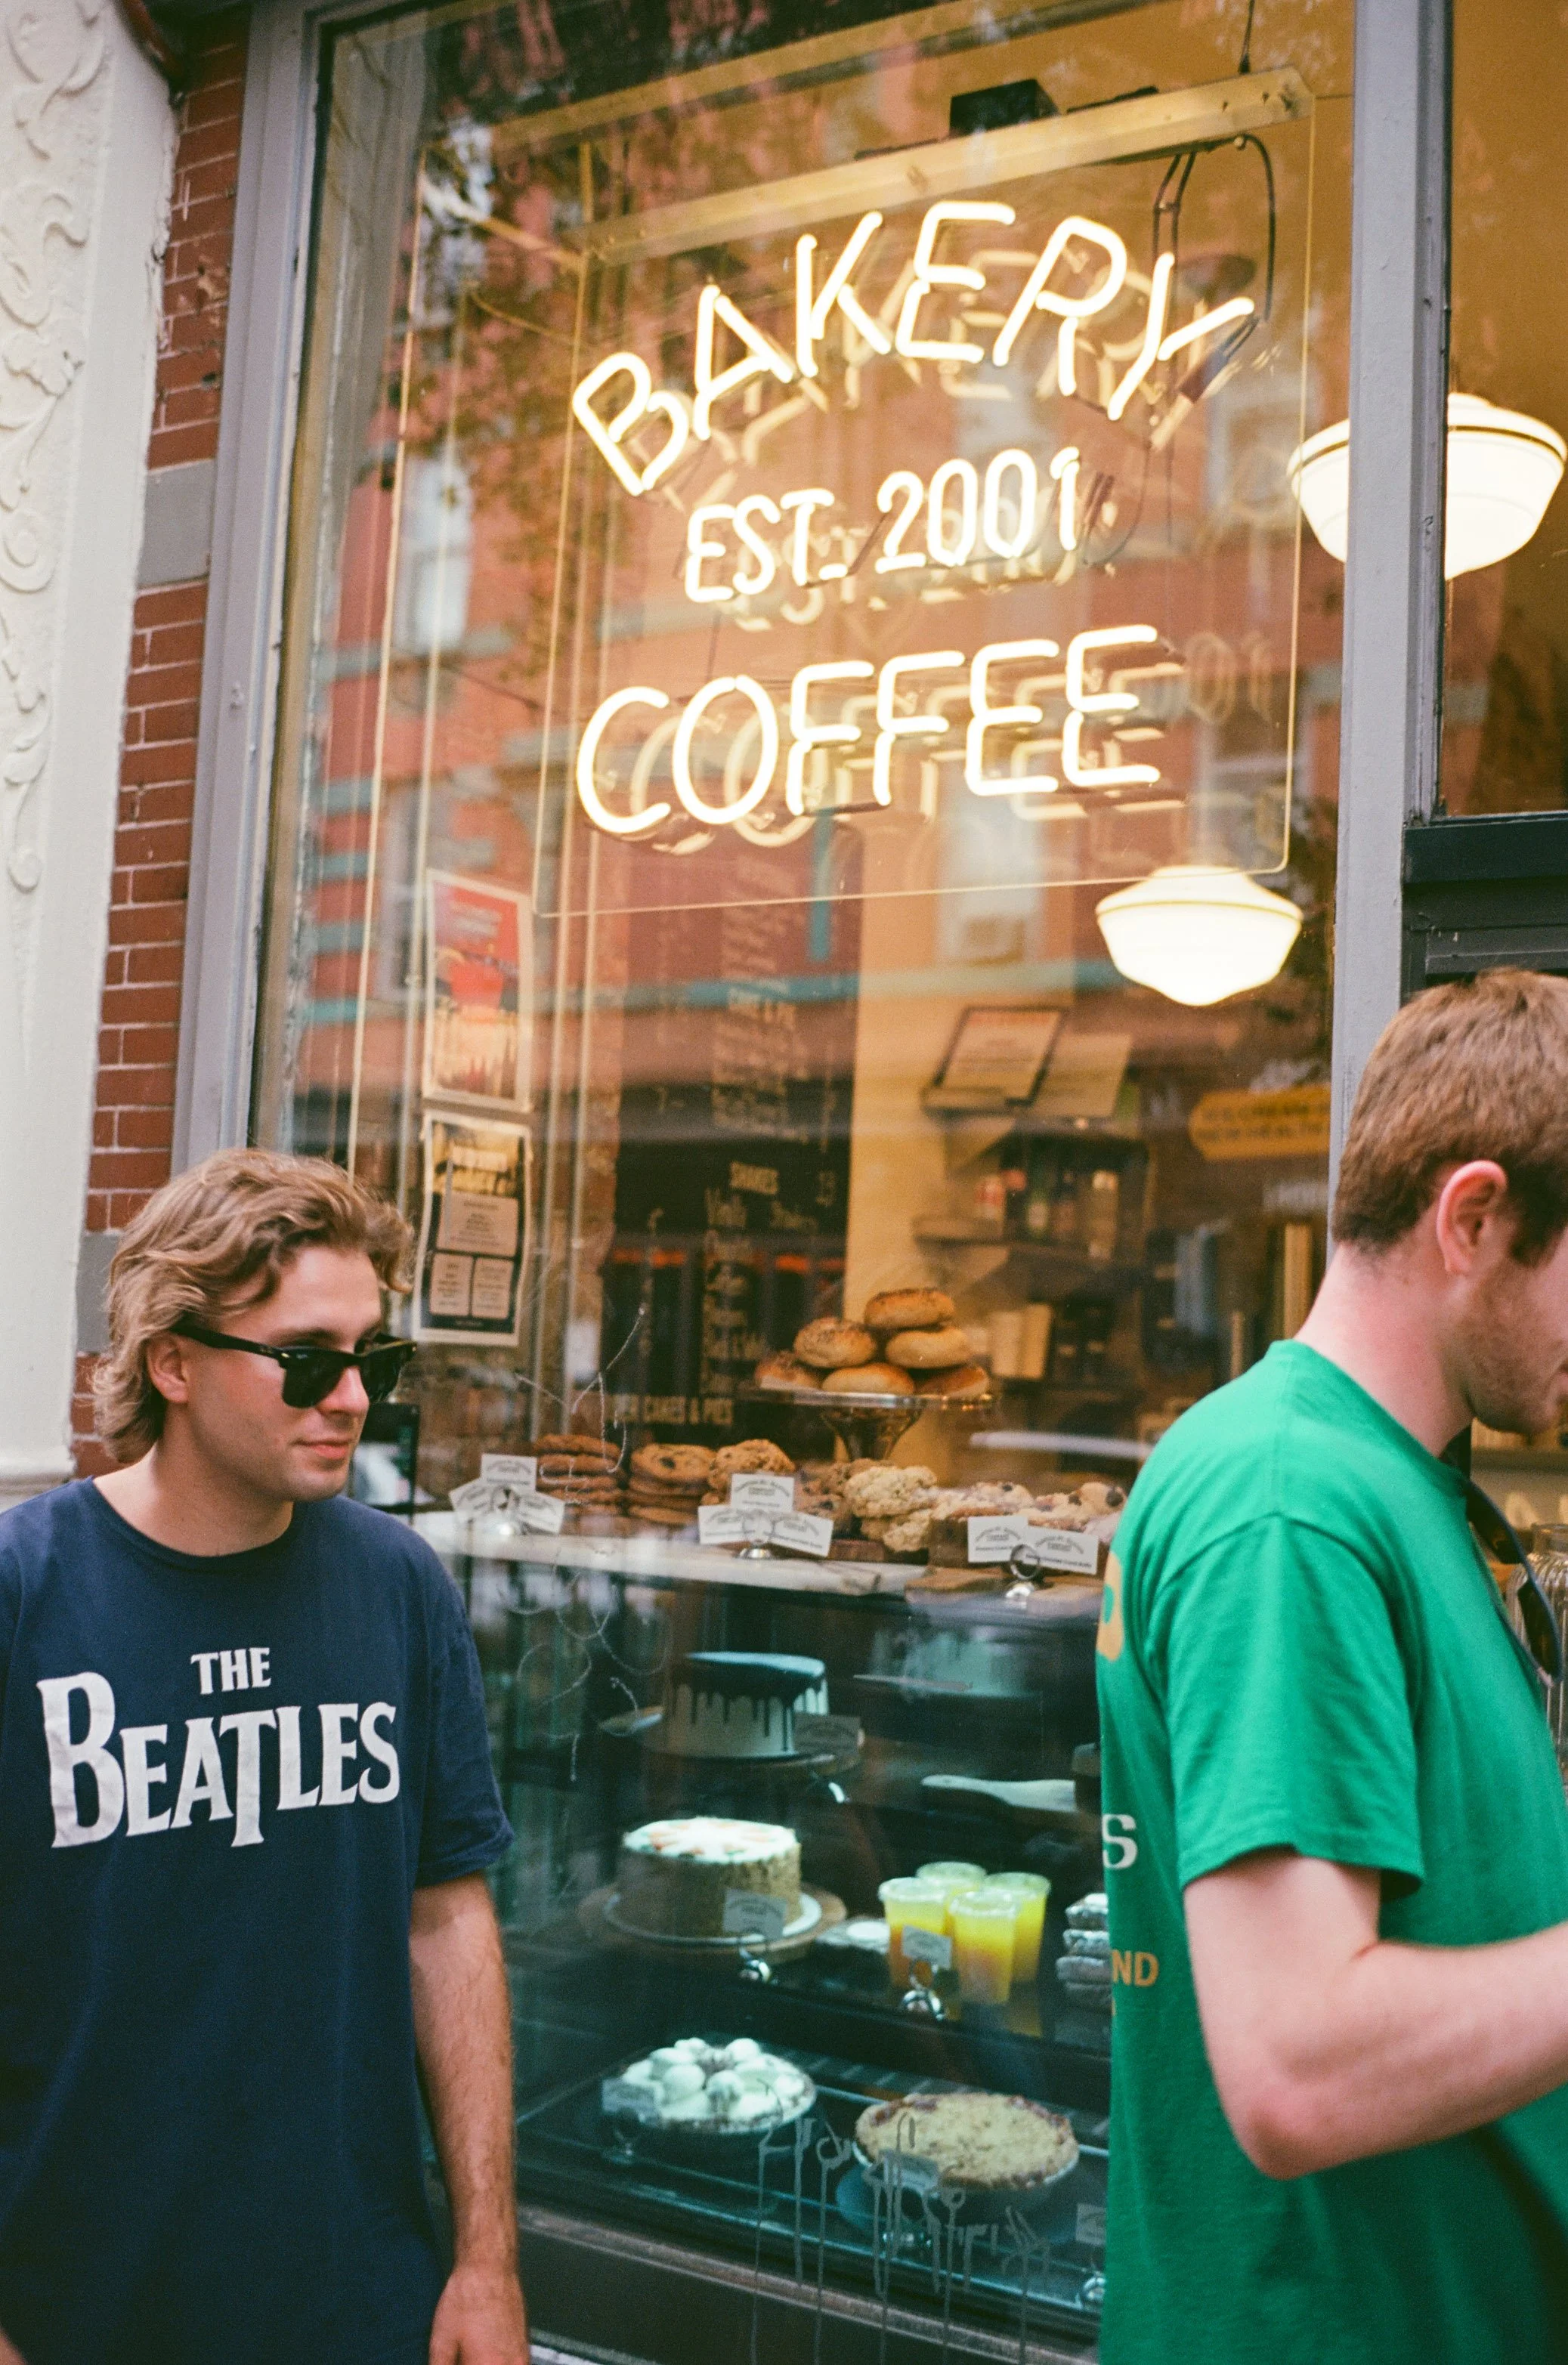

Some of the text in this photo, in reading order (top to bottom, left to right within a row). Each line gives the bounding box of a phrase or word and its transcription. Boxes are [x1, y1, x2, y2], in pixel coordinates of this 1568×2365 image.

[572, 201, 1254, 496] BAKERY
[685, 447, 1079, 602] EST. 2001
[576, 625, 1161, 835] COFFEE
[190, 1646, 272, 1695] THE
[36, 1671, 401, 1848] BEATLES
